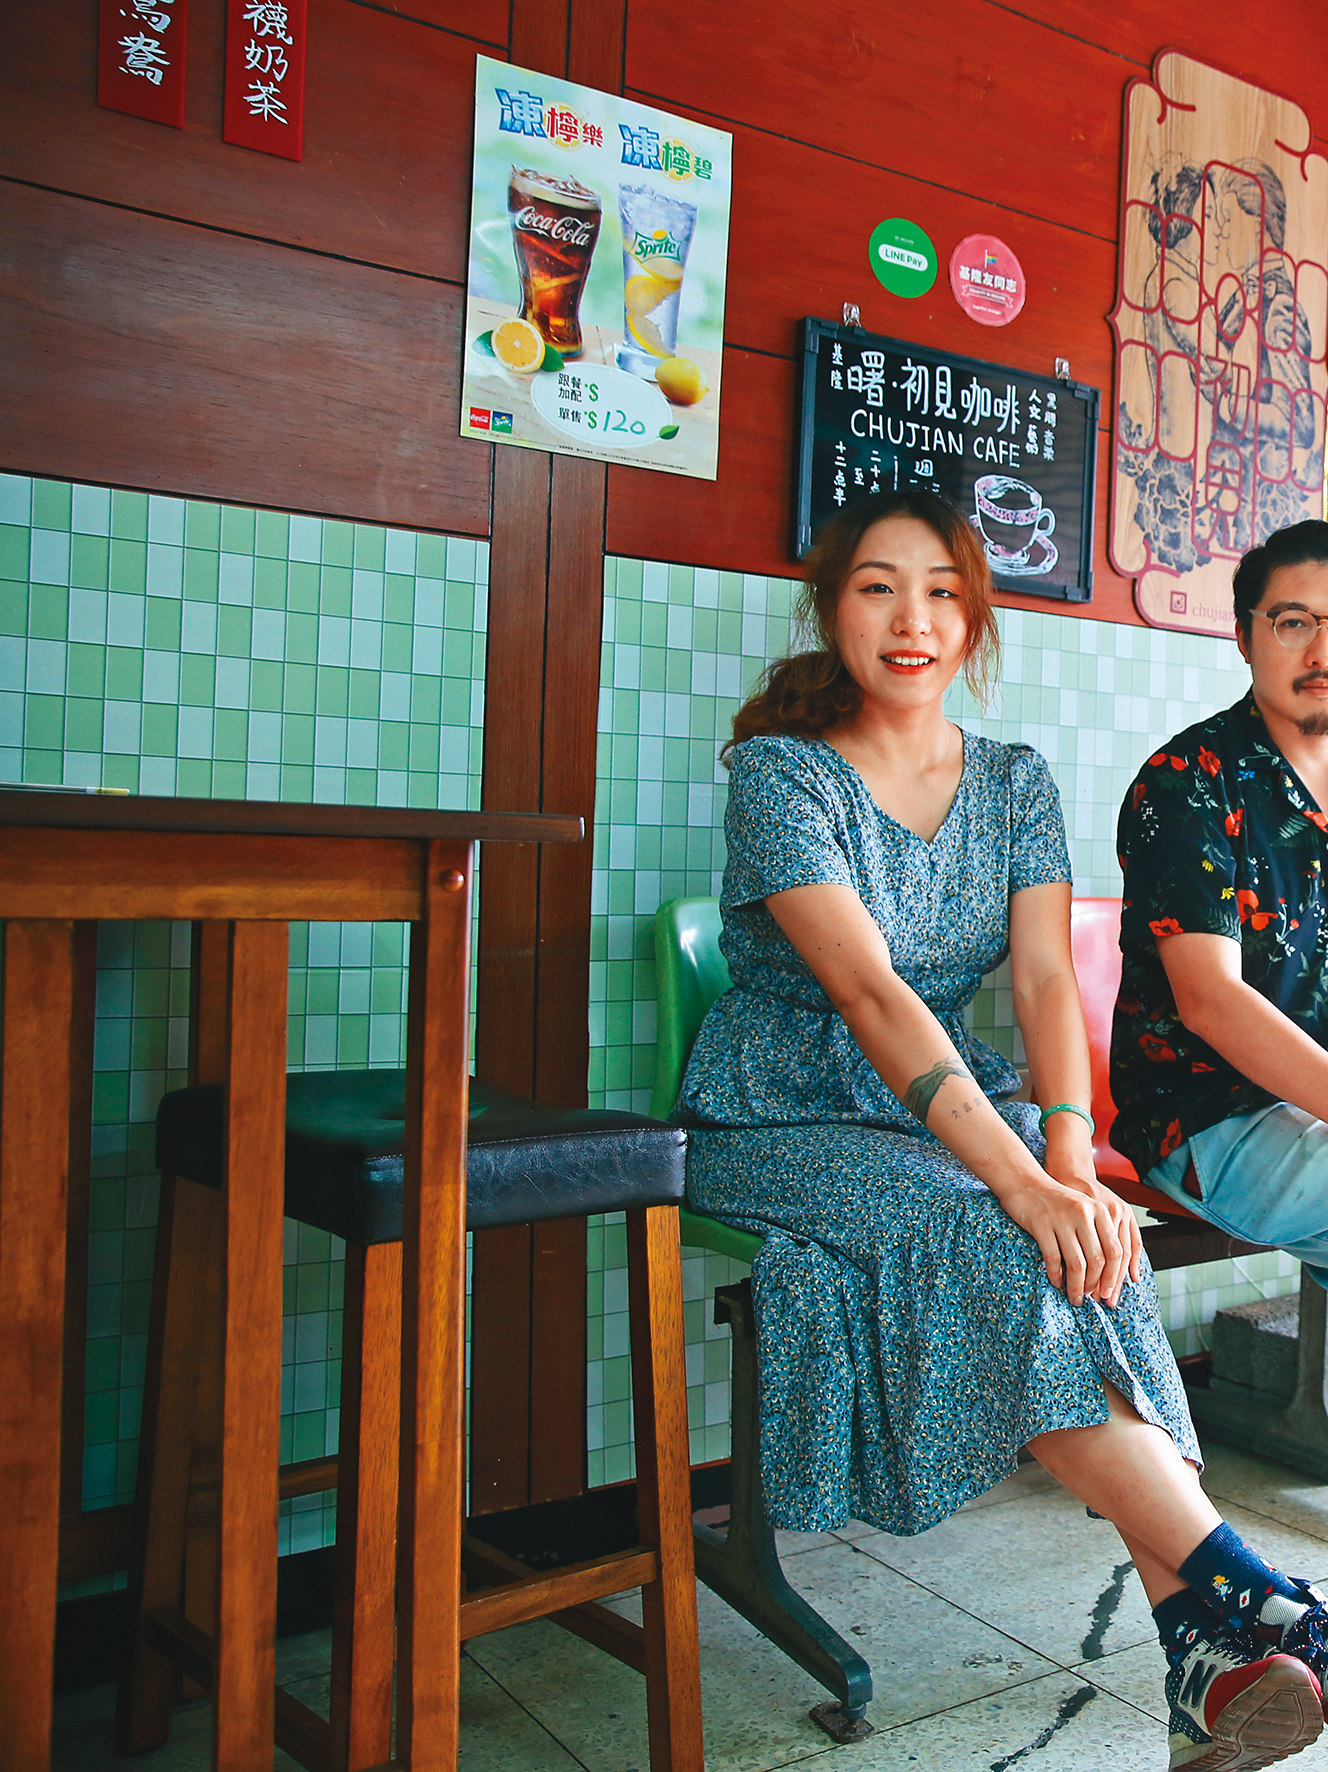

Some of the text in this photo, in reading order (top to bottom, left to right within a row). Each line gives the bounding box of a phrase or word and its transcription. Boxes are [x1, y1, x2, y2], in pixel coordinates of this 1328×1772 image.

[494, 87, 605, 148] 凍檸樂
[618, 123, 713, 180] 凍檸碧
[514, 205, 596, 247] Coca-Cola
[634, 237, 678, 259] Sprite
[884, 249, 923, 268] LINE Pay
[850, 408, 1021, 468] CHUJIAN CAFE
